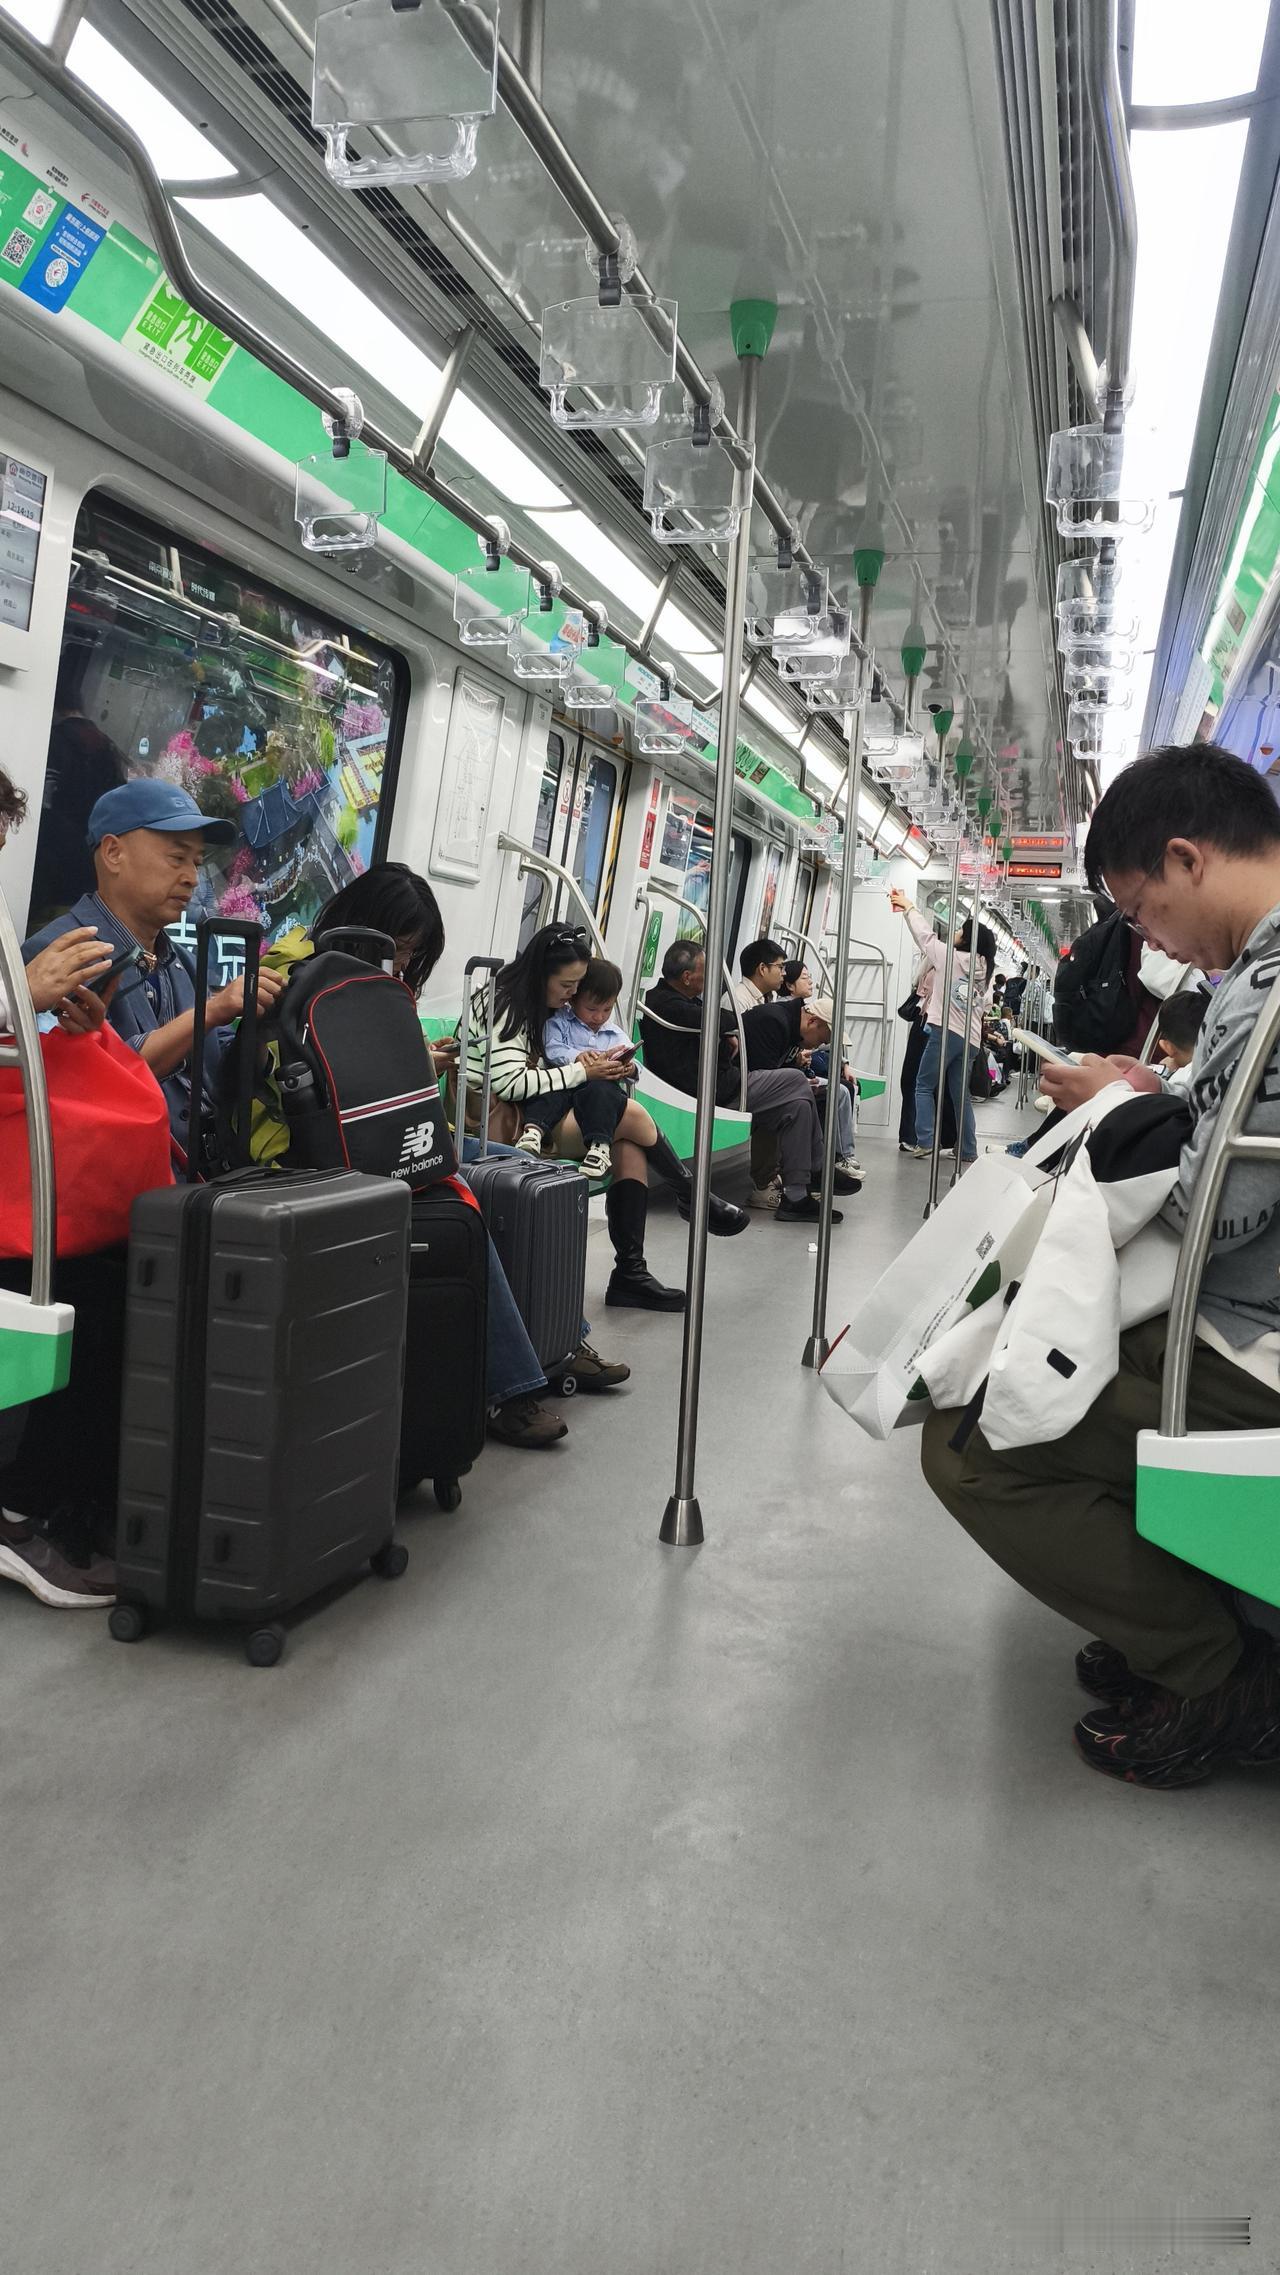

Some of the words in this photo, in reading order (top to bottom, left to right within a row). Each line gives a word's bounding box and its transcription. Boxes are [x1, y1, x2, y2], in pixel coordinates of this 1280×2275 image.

[142, 320, 161, 337] EXIT
[196, 361, 214, 375] EXIT
[391, 1166, 410, 1179] new
[411, 1154, 443, 1173] balance
